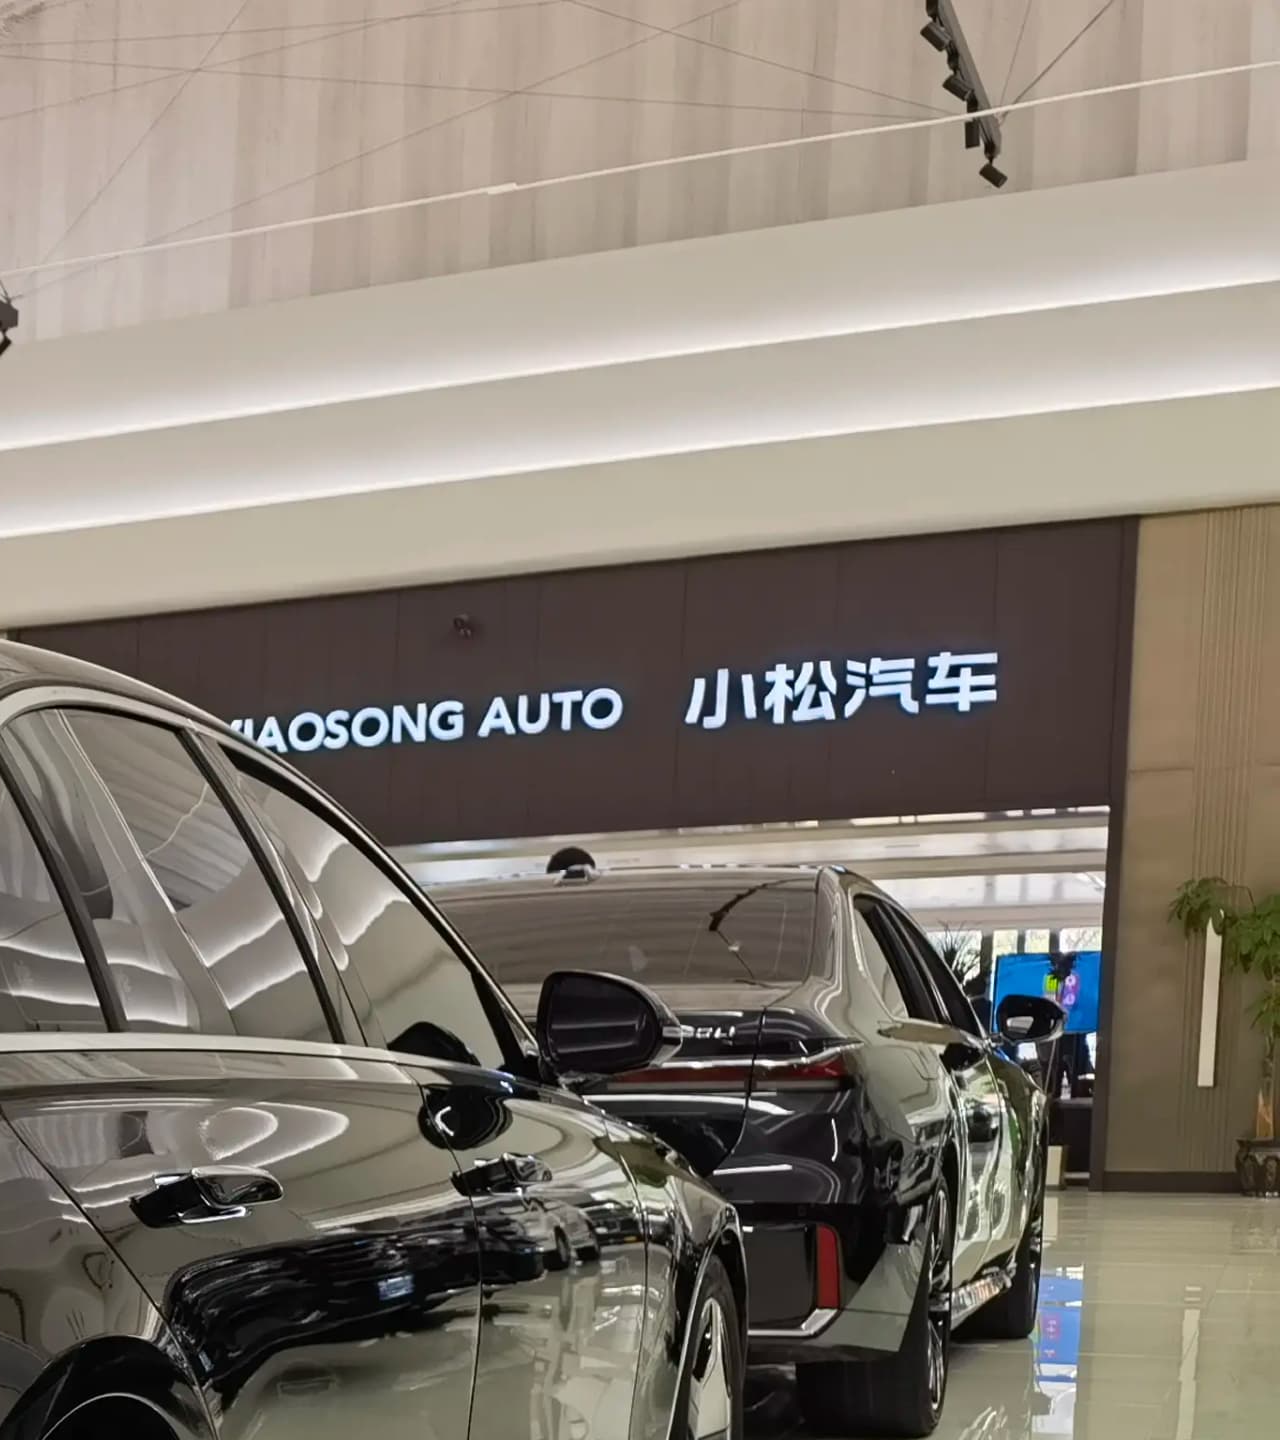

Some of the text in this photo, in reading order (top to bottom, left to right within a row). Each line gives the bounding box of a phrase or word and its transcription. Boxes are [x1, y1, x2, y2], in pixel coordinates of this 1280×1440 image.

[478, 687, 624, 738] AUTO
[684, 650, 999, 730] 小松汽车
